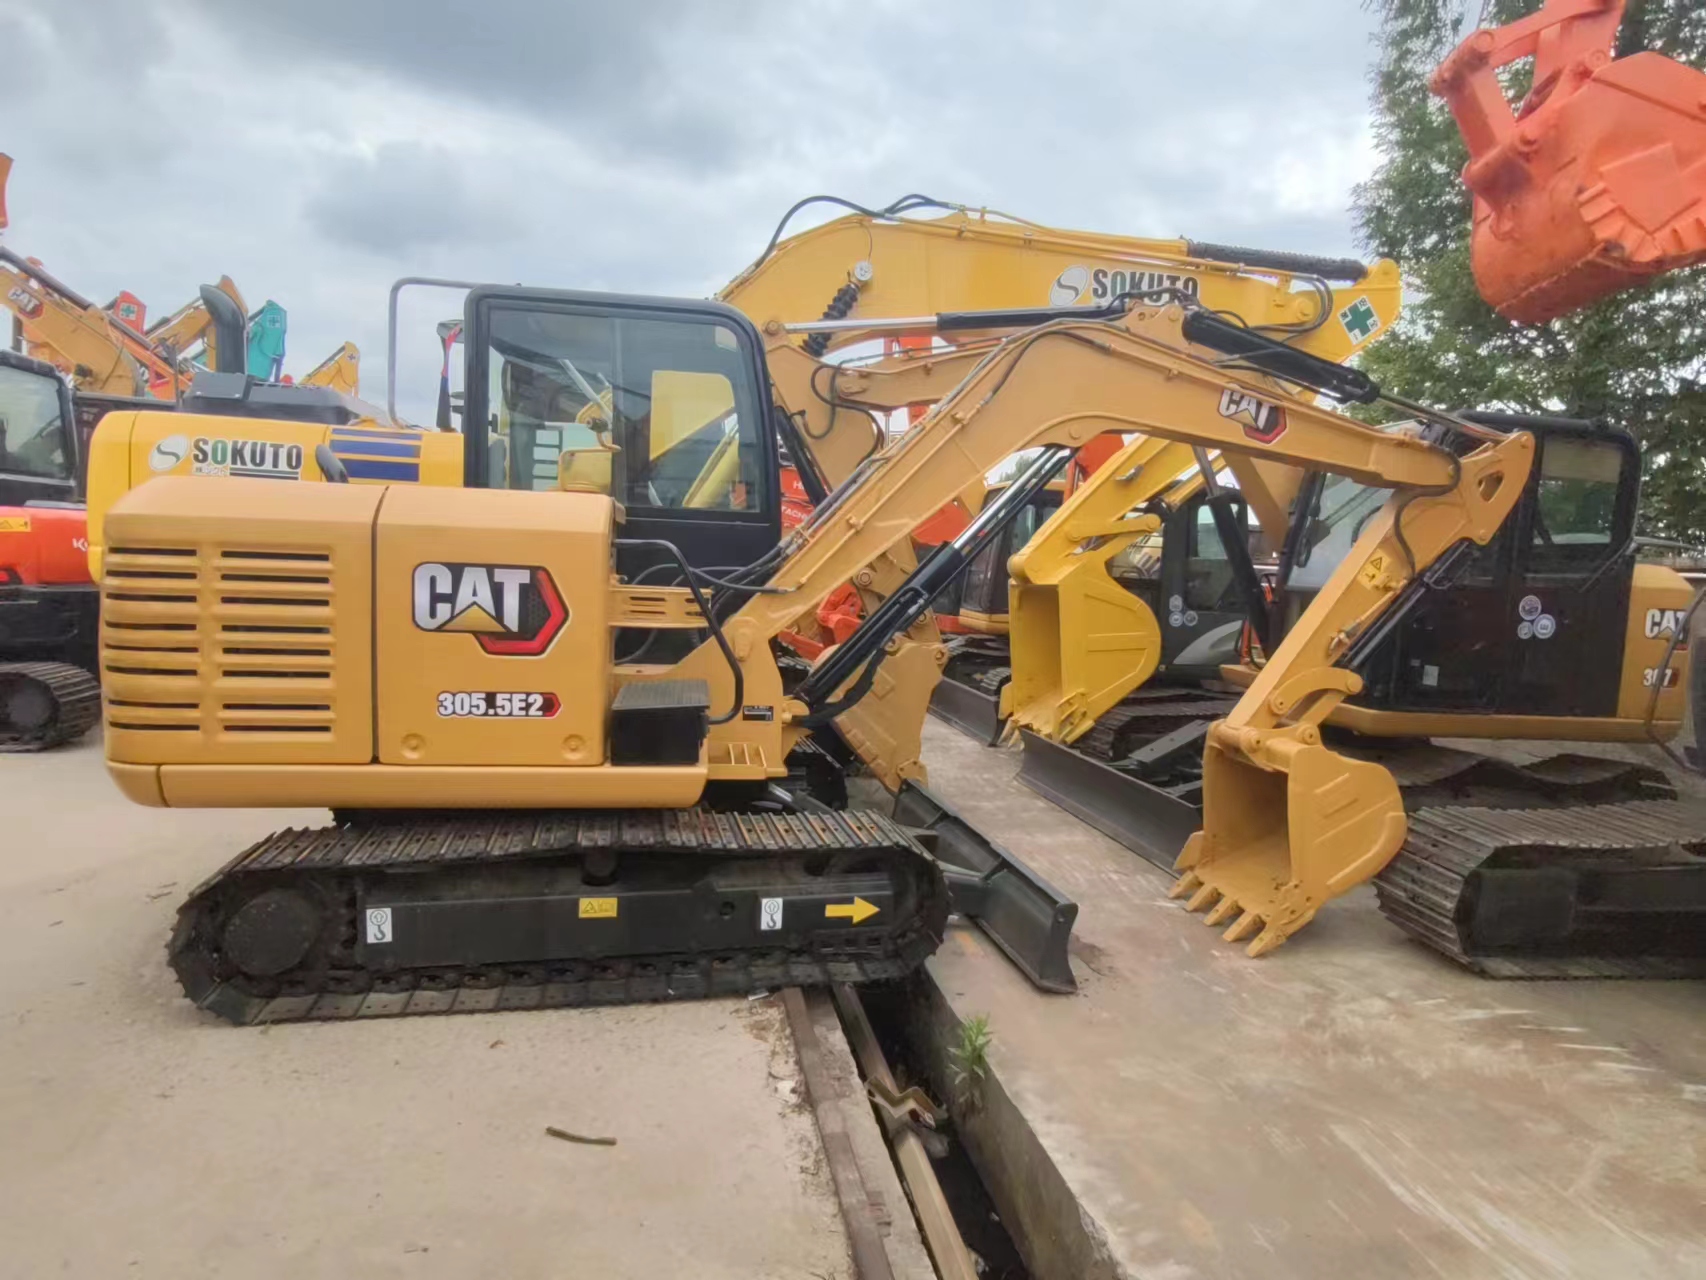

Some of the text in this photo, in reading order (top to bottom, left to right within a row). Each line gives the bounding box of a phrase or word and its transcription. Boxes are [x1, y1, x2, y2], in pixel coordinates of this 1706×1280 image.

[193, 437, 303, 470] SOKUTO
[414, 563, 530, 632] CAT
[438, 692, 543, 716] 305.5E2
